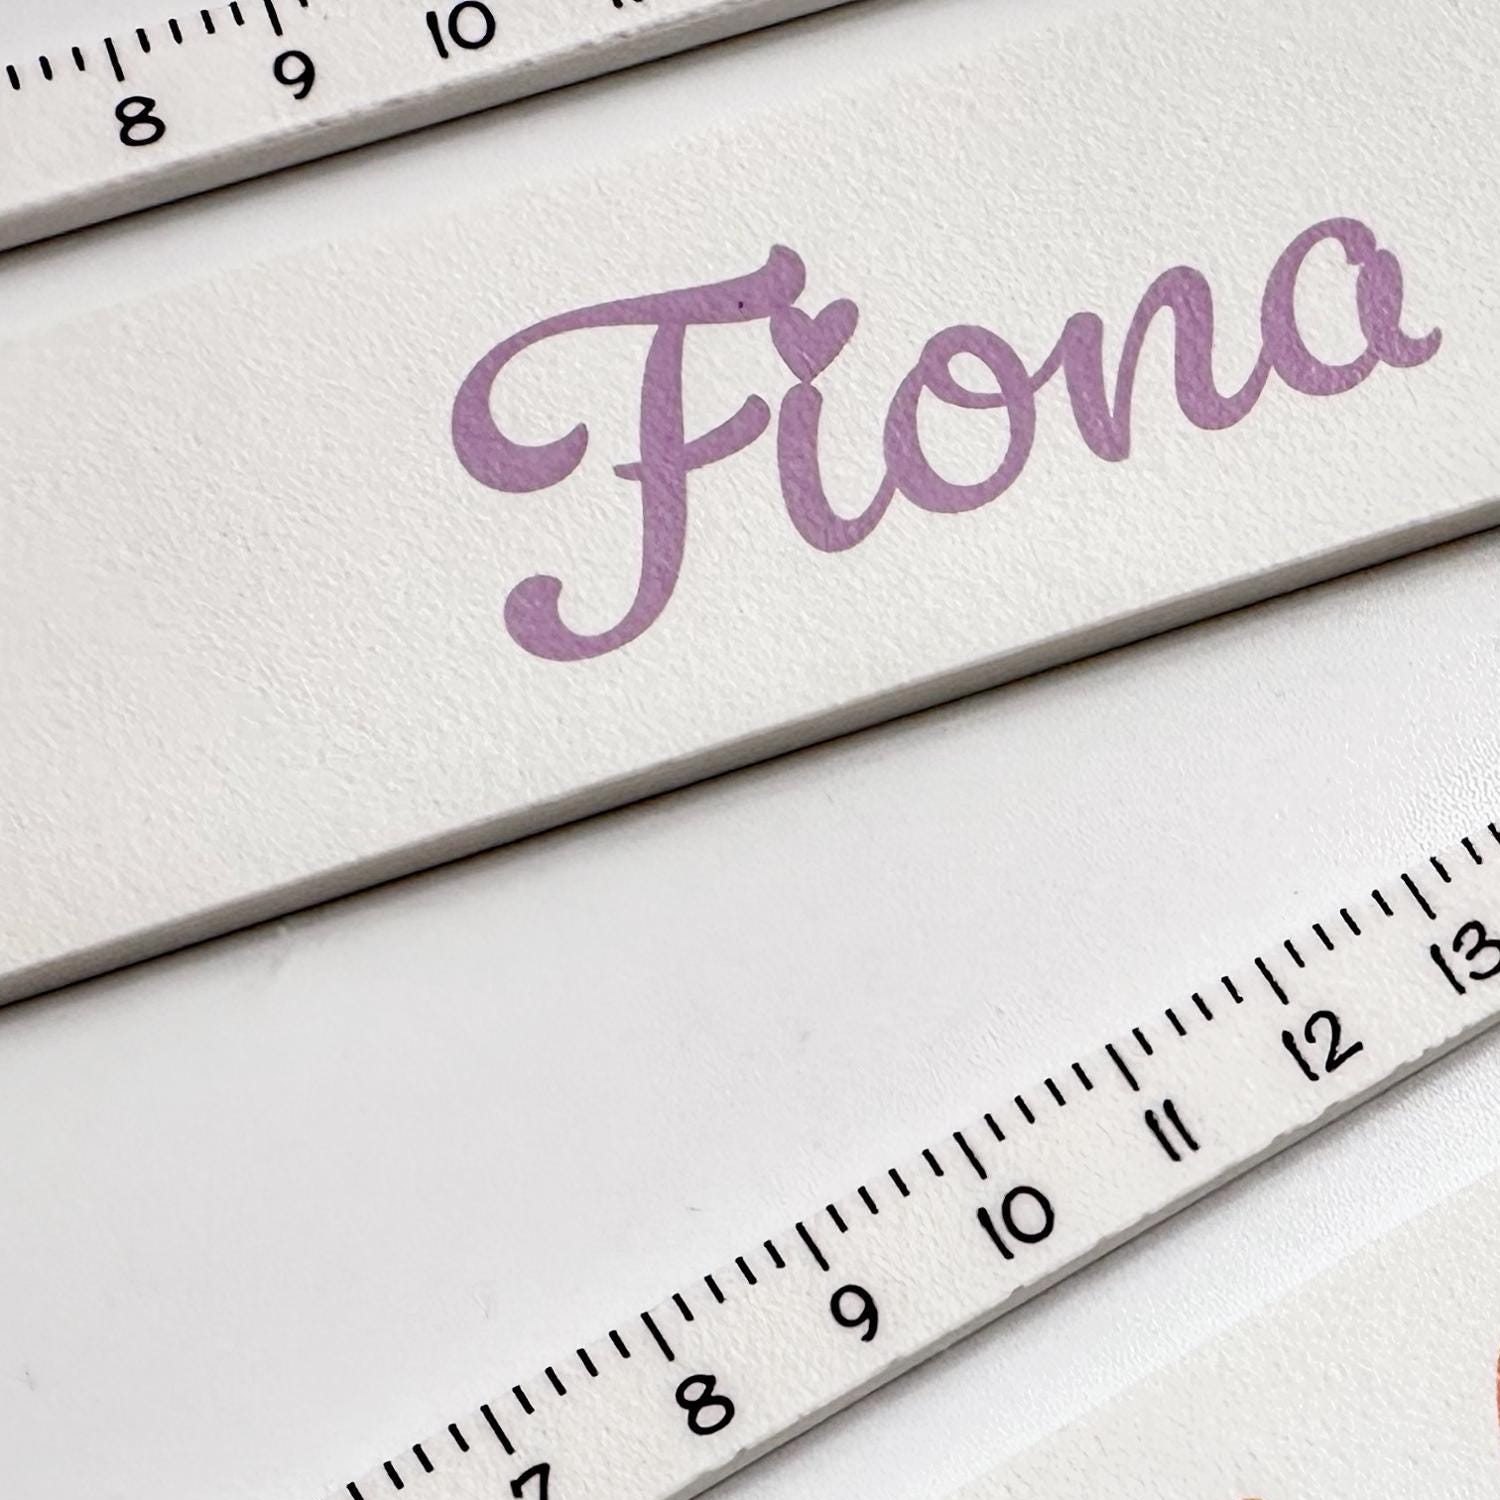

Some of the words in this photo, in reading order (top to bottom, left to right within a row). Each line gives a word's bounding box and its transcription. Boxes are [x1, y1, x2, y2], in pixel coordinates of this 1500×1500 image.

[113, 94, 168, 148] 8
[272, 49, 317, 101] 9
[424, 0, 498, 61] 10
[450, 218, 1442, 663] Fiona
[674, 1373, 737, 1437] 8
[828, 1283, 880, 1344] 9
[975, 1184, 1056, 1261] 10
[1143, 1097, 1201, 1163] 11
[1280, 1009, 1365, 1083] 12
